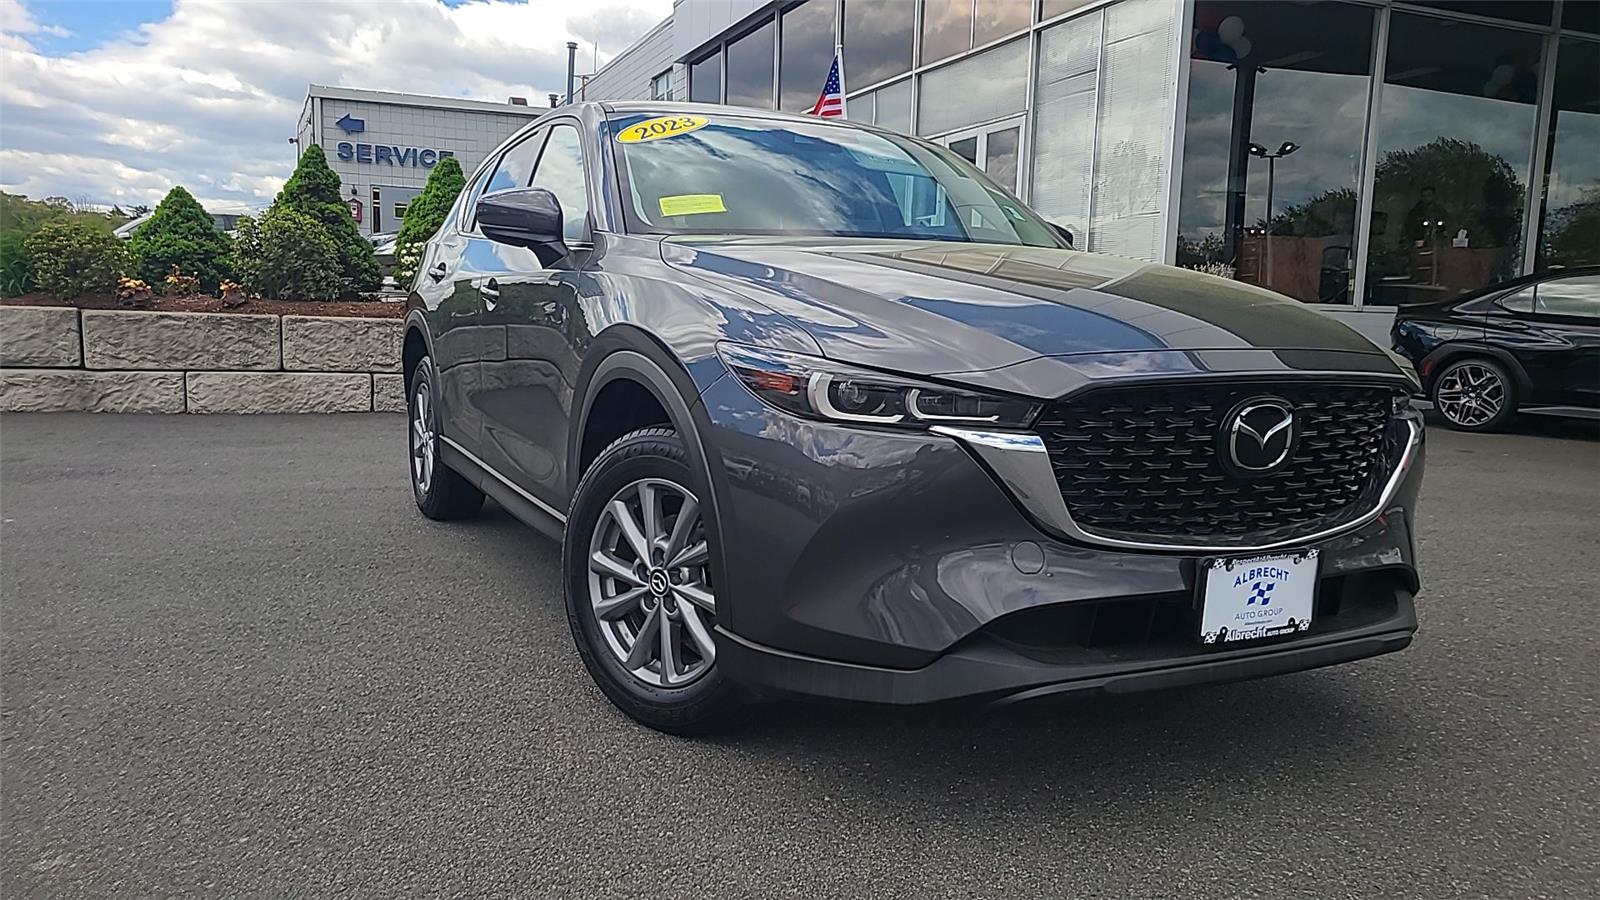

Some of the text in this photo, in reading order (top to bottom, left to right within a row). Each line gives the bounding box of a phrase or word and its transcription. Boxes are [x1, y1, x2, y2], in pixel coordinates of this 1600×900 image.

[634, 117, 696, 140] 2023
[337, 142, 455, 169] SERVIC
[1233, 567, 1290, 588] ALBRECHT
[1234, 607, 1284, 620] AUTO GROUP
[1224, 626, 1267, 642] Albrecht
